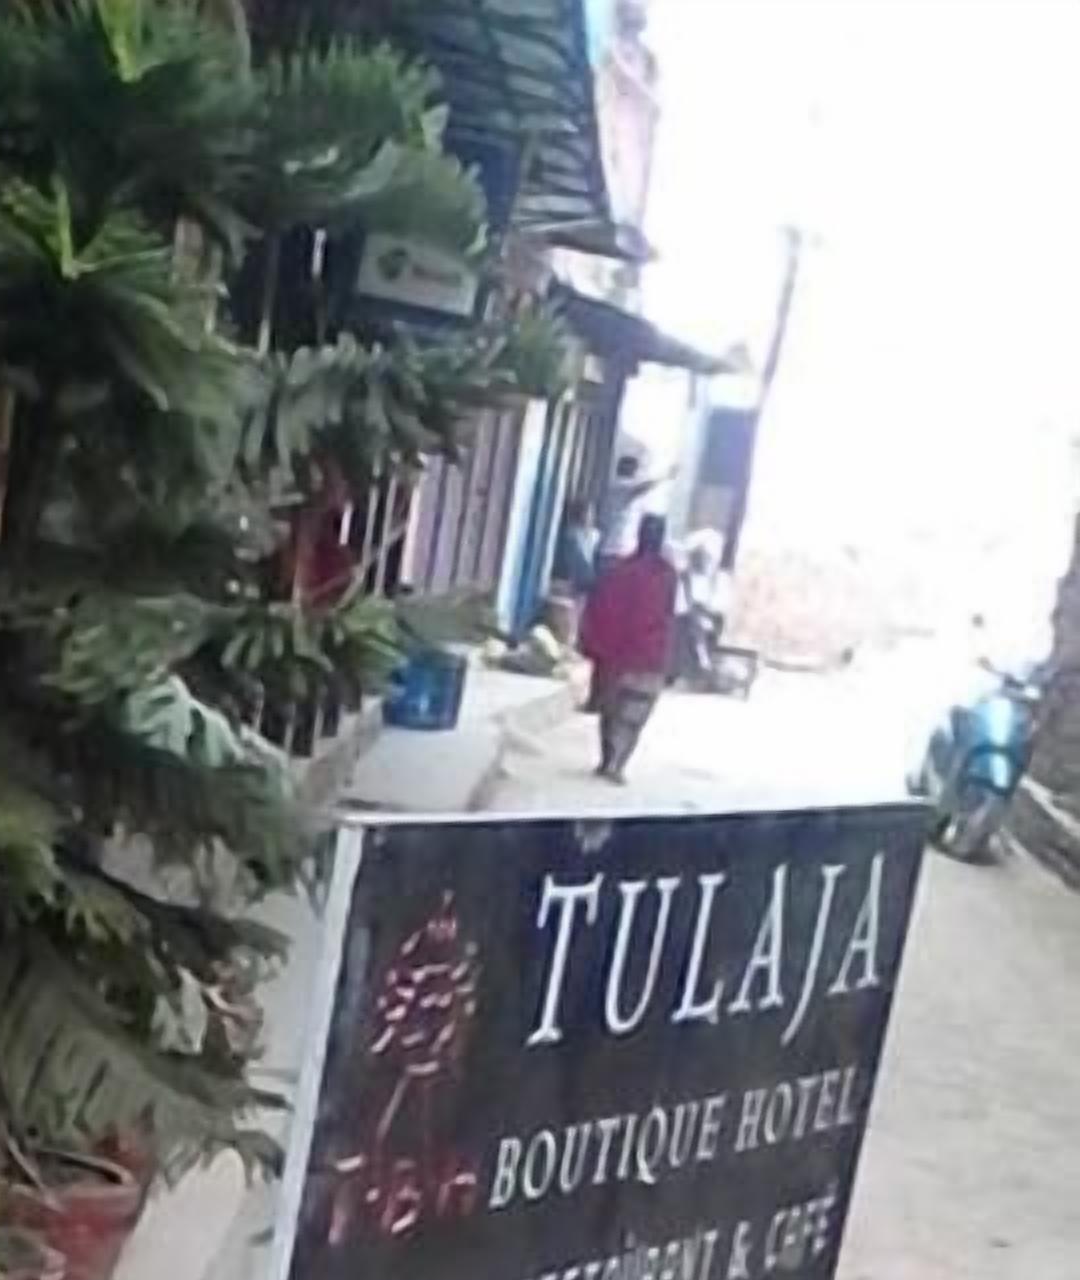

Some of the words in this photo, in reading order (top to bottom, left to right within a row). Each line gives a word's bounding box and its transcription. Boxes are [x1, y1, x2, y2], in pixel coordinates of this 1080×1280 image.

[526, 852, 885, 1047] TULAJA
[489, 1096, 725, 1208] BOUTIQUE
[734, 1065, 857, 1152] HOTEL
[728, 1219, 752, 1280] &
